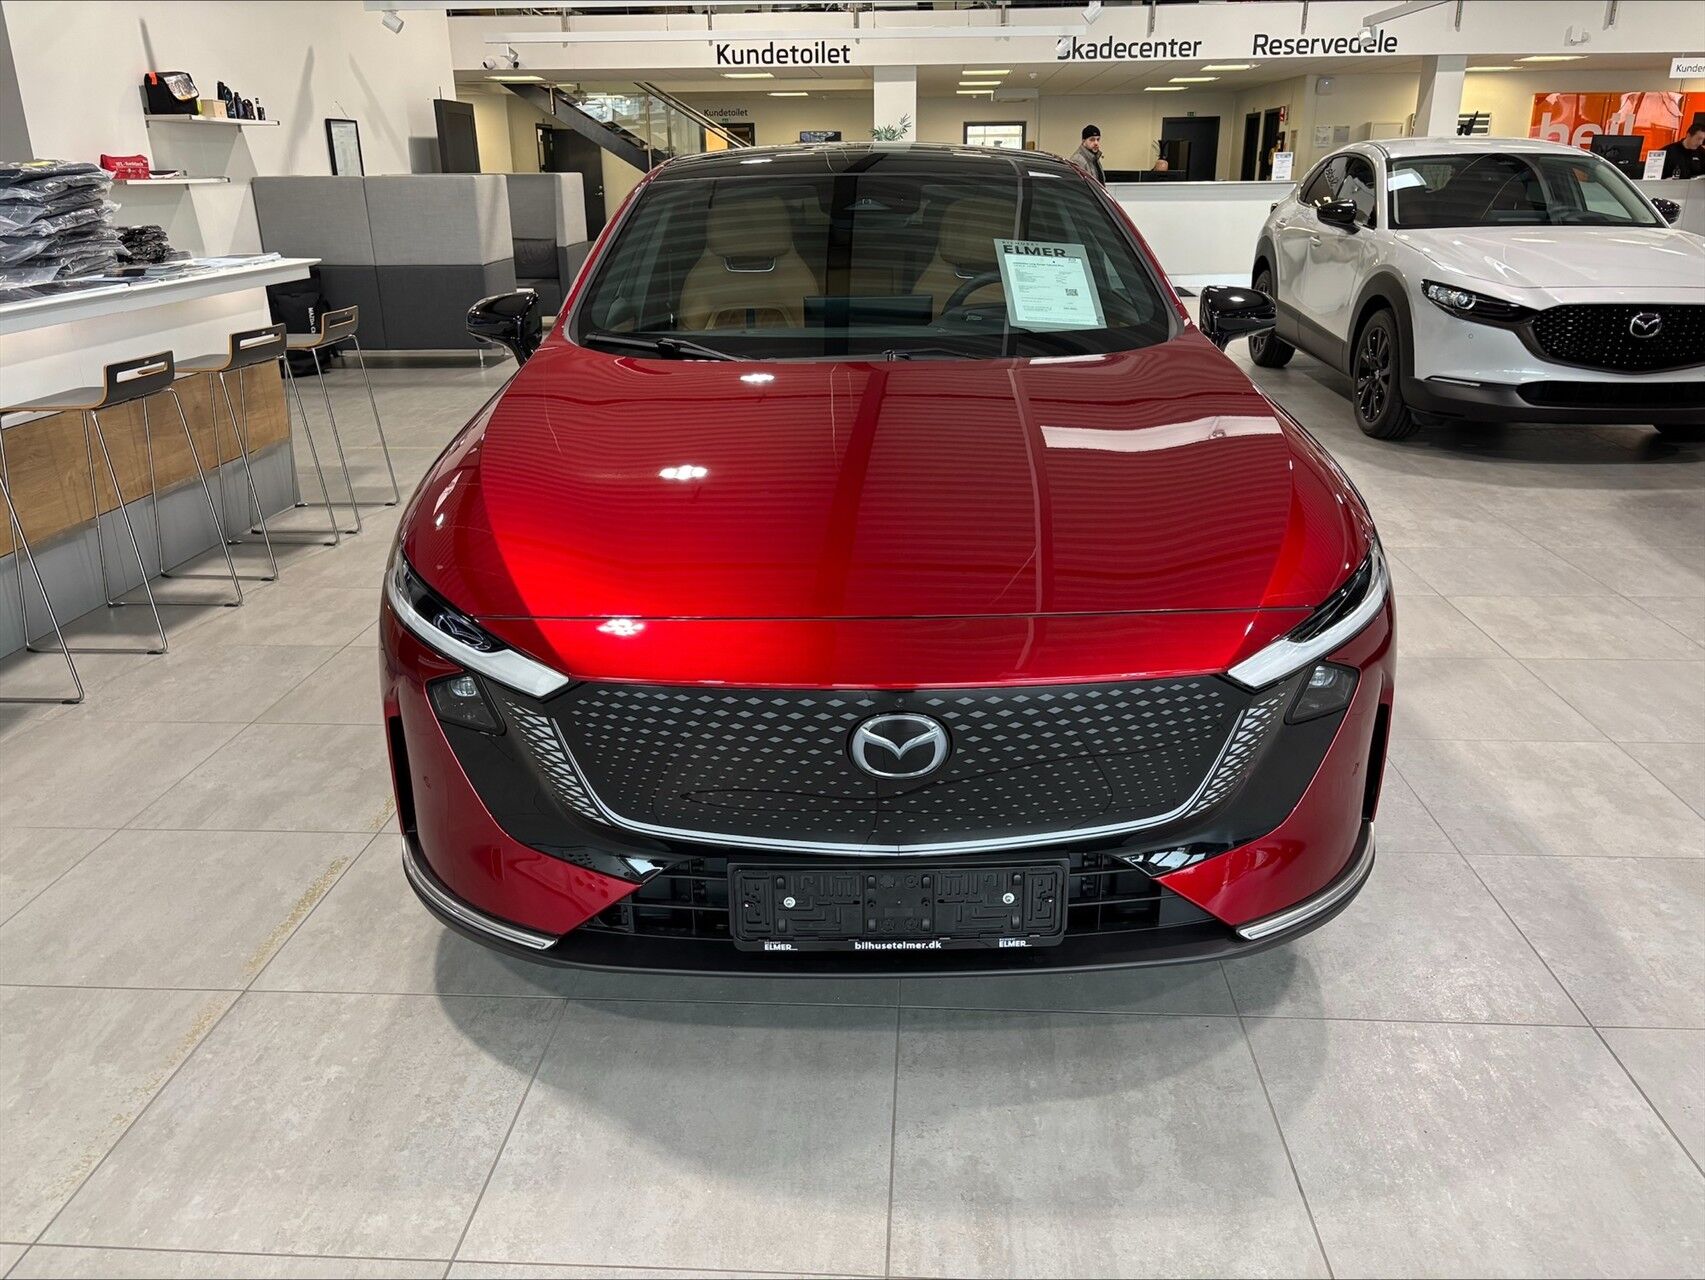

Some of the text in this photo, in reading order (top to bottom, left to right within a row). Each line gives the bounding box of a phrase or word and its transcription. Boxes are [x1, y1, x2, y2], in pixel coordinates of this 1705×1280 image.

[716, 41, 851, 65] Kundetoilet
[703, 108, 748, 117] Kundetoilet
[1003, 244, 1066, 258] ELMER
[764, 943, 792, 951] ELMER
[854, 941, 942, 950] bilhusetelmer.dk
[998, 940, 1027, 948] ELMER
